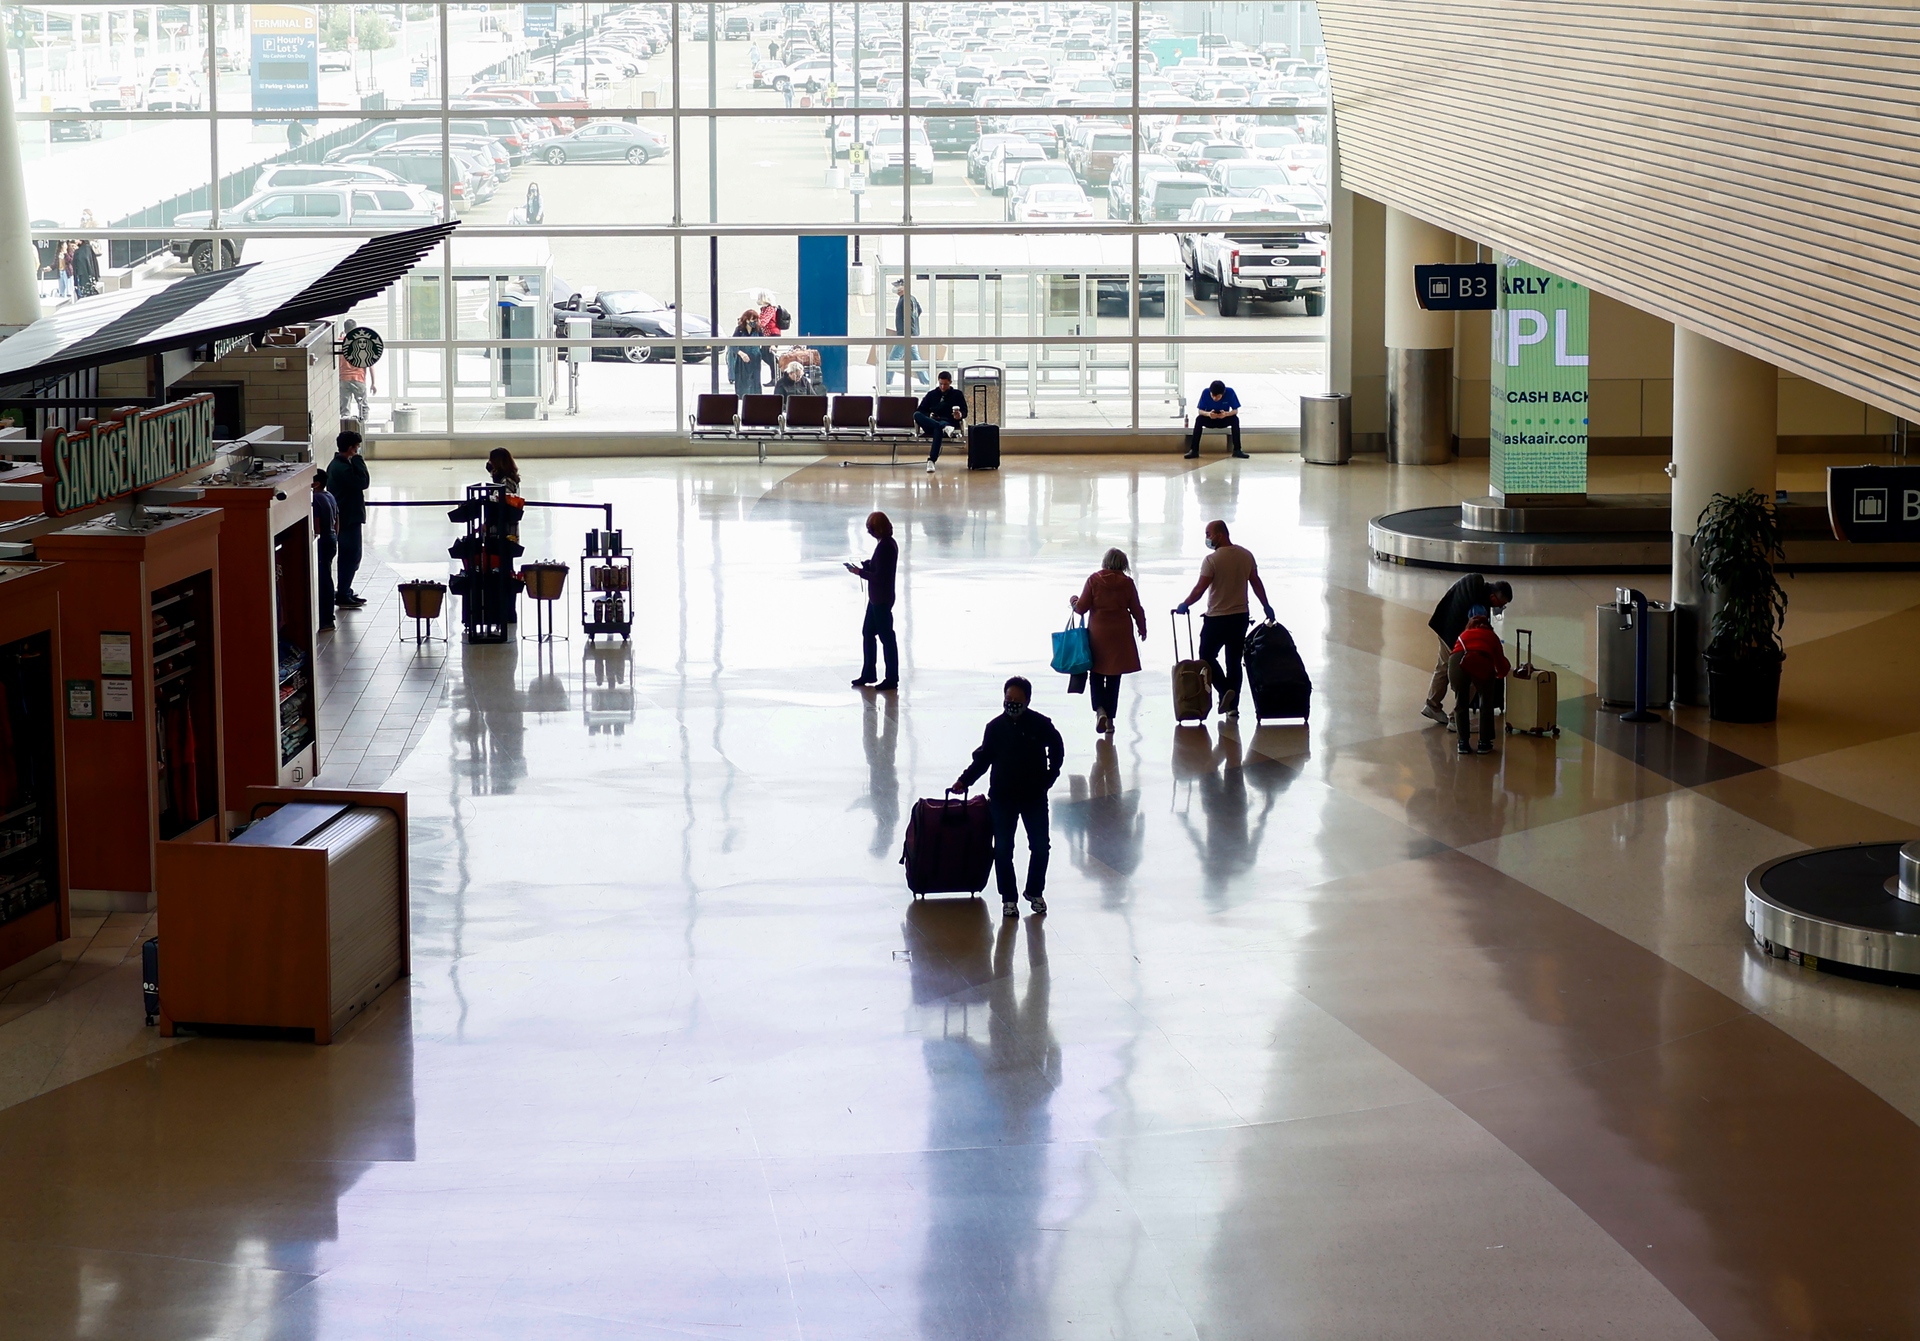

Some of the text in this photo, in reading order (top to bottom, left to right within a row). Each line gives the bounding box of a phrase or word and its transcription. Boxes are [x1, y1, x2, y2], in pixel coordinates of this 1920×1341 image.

[253, 17, 314, 29] TERMINAL B
[266, 40, 272, 48] P
[277, 36, 305, 45] Hourly
[1459, 277, 1487, 297] B3
[1507, 391, 1548, 403] CASH
[56, 397, 217, 512] SAN JOSE MARKETPLACE
